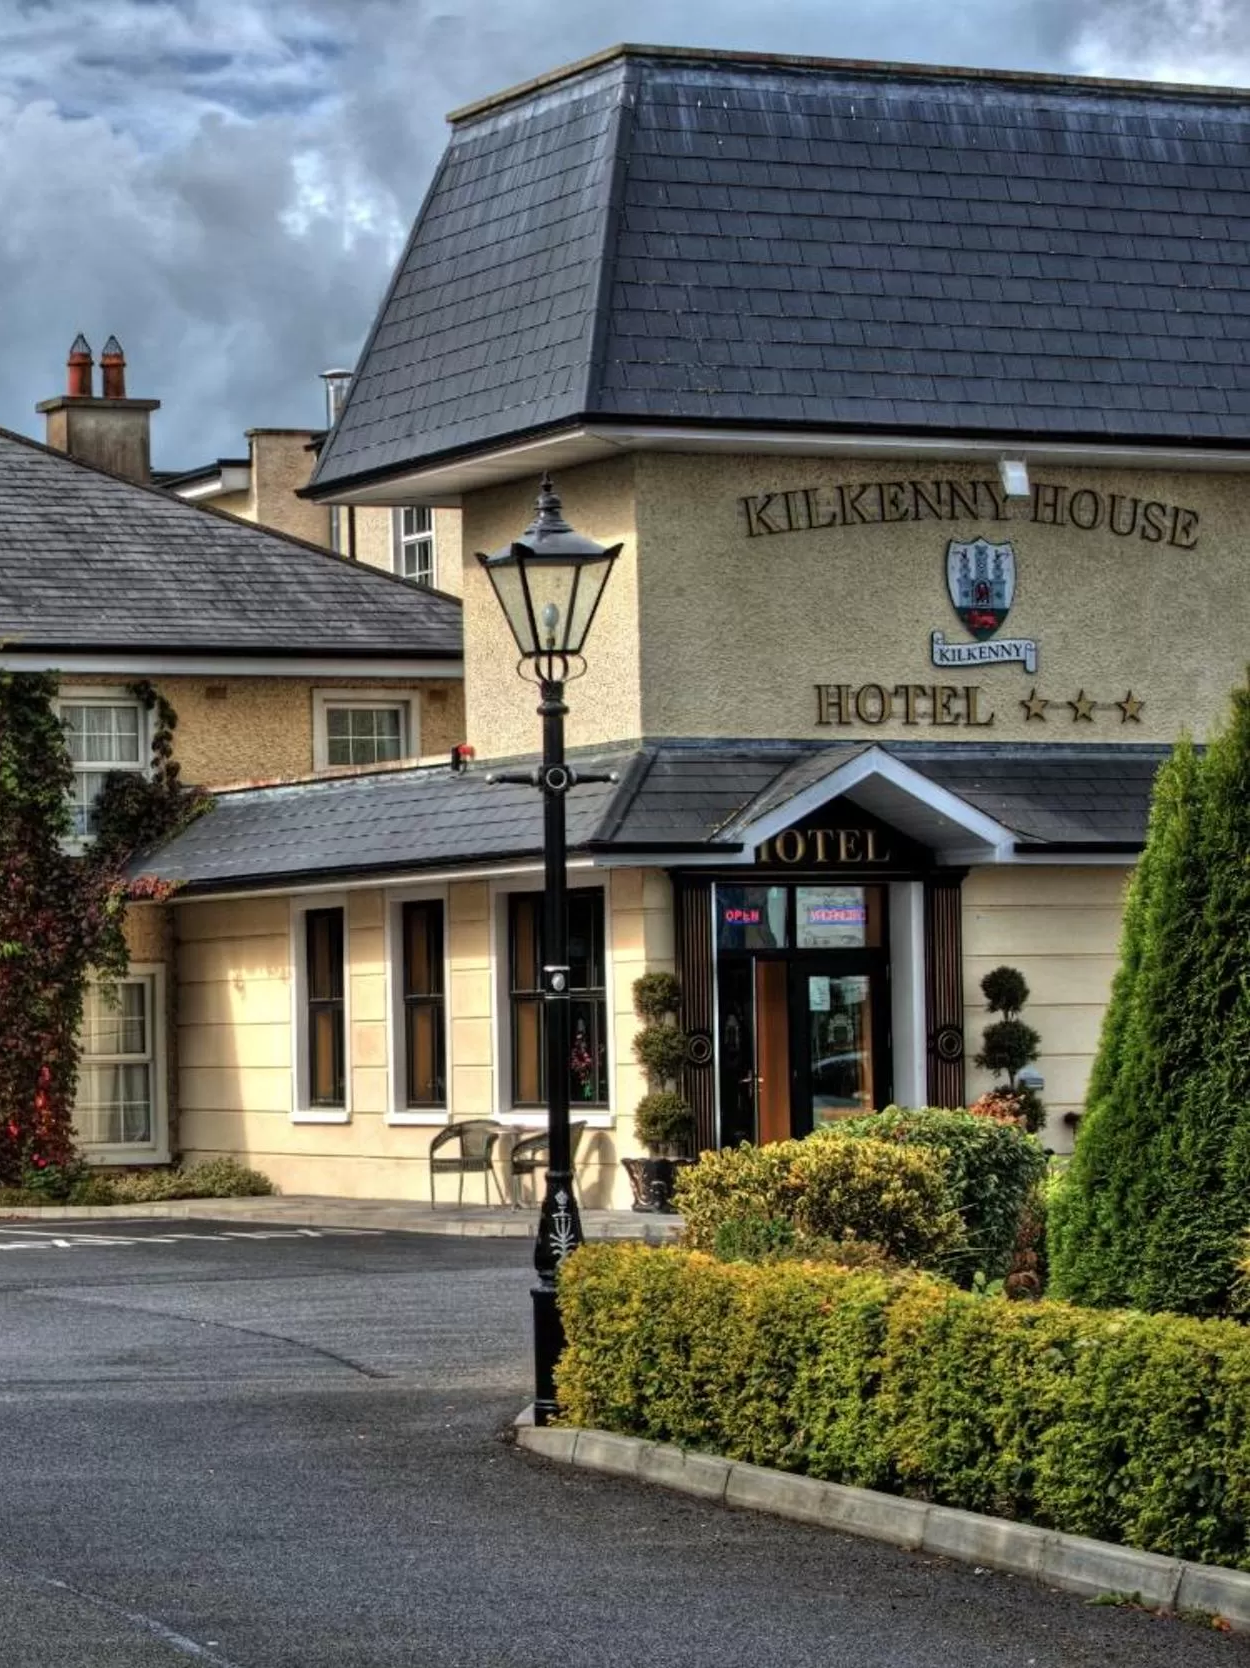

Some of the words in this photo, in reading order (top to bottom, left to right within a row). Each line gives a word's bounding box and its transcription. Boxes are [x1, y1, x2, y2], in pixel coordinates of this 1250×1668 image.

[738, 480, 1011, 538] KILKENNY
[1030, 483, 1200, 551] HOUSE
[938, 643, 1023, 663] KILKENNY
[813, 683, 995, 727] HOTEL
[724, 908, 760, 922] OPEN
